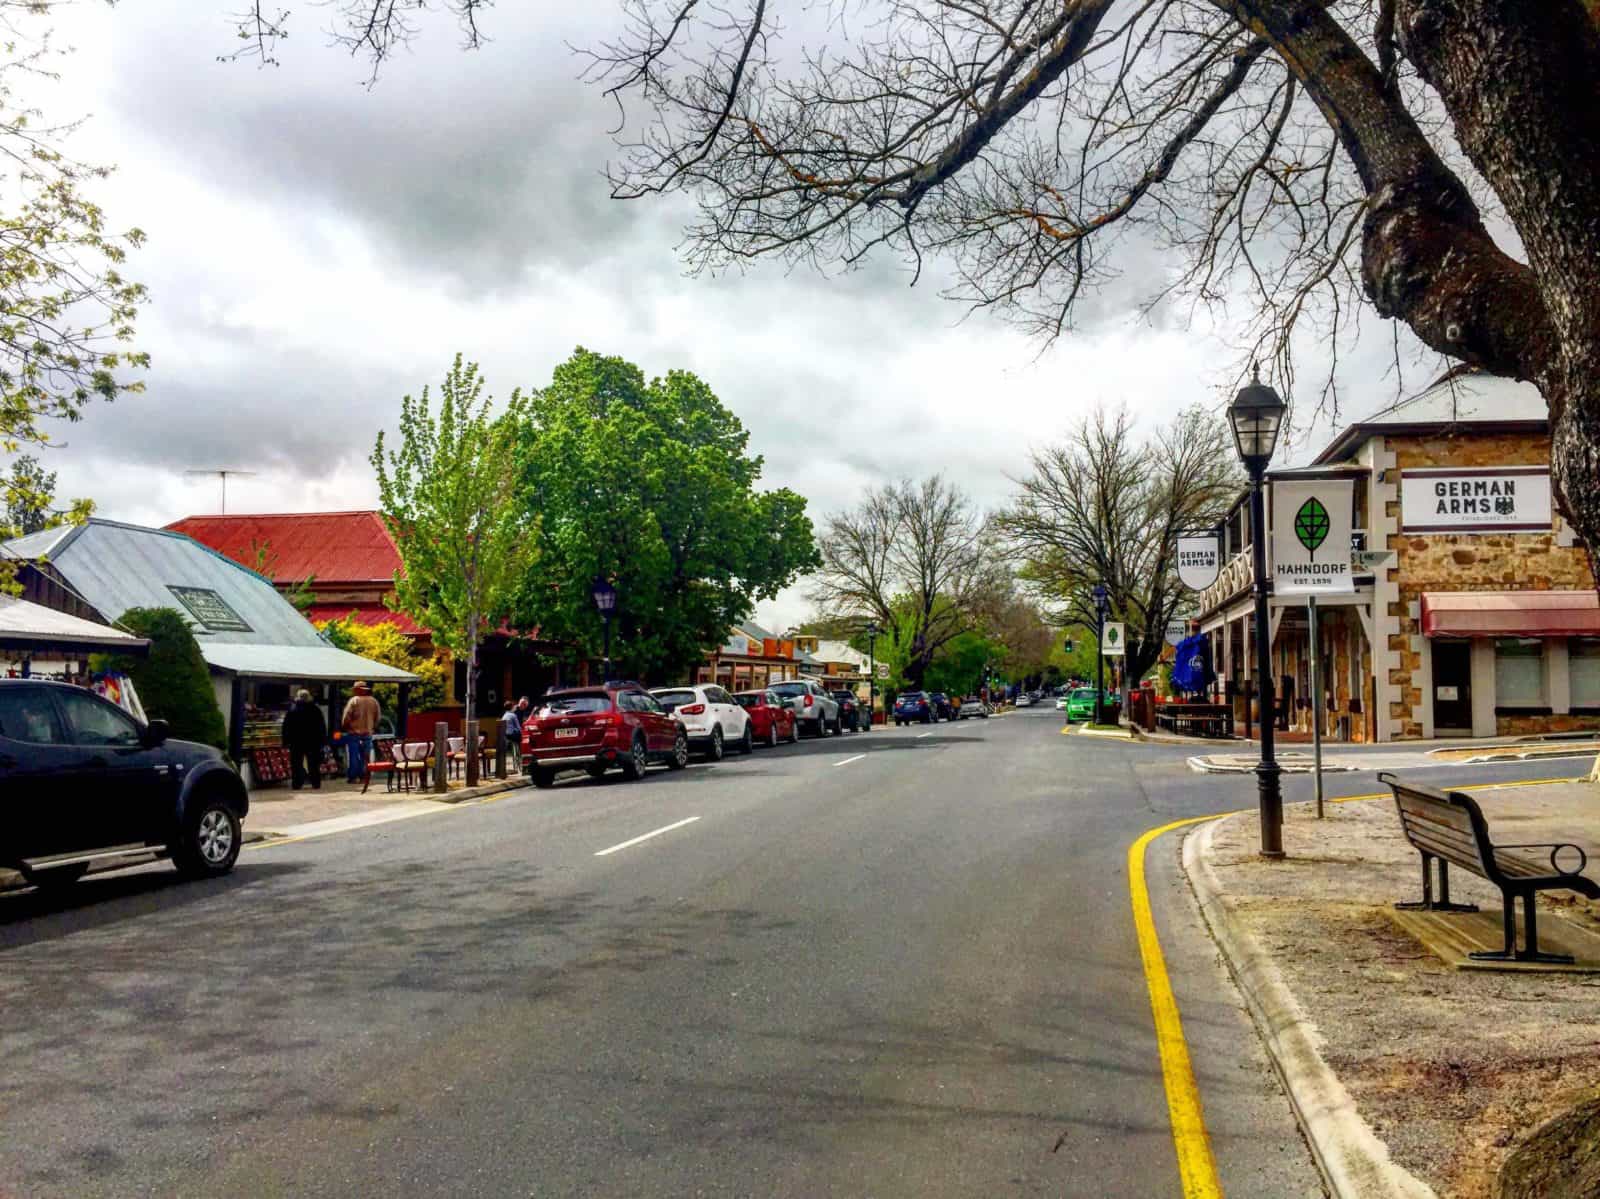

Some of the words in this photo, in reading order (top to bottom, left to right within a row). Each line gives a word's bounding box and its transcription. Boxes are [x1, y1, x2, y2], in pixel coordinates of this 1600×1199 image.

[1435, 481, 1515, 497] GERMAN
[1436, 498, 1491, 514] ARMS
[1180, 551, 1215, 559] GERMAN
[1180, 559, 1205, 567] ARMS
[1277, 563, 1346, 575] HAHNDORF
